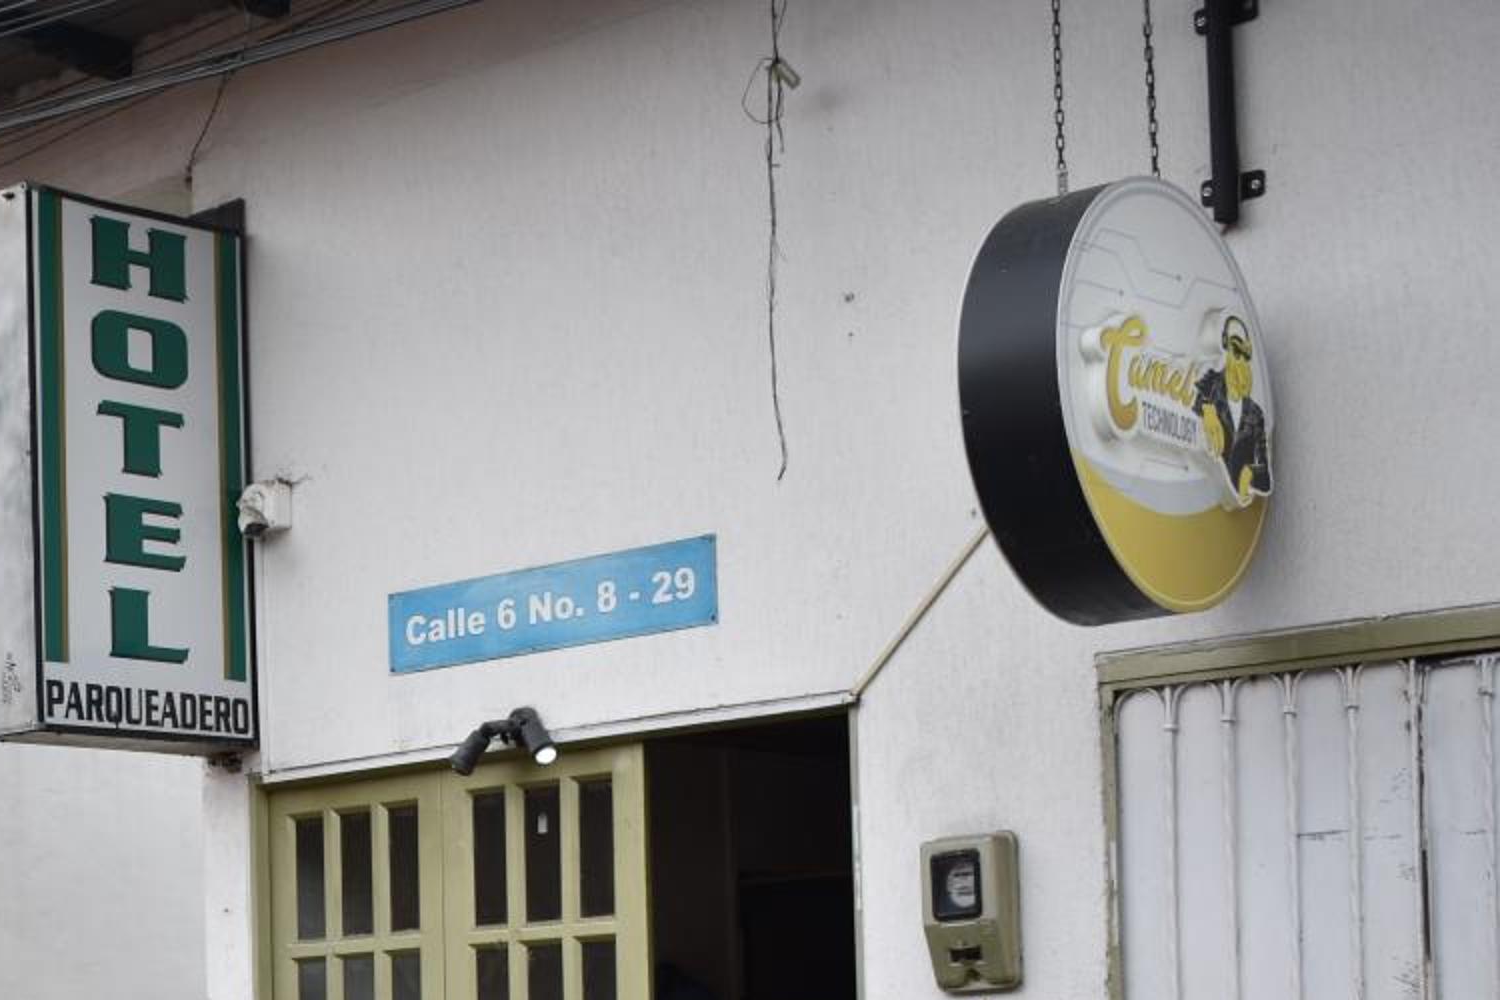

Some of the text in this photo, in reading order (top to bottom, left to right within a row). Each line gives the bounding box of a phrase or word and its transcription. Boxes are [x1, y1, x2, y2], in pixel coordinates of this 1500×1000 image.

[90, 214, 191, 666] HOTEL
[1142, 401, 1198, 445] TECHNOLOGY
[406, 607, 486, 646] Calle
[497, 599, 517, 630] 6
[528, 591, 585, 624] No.
[596, 581, 618, 613] 8
[651, 567, 696, 604] 29
[46, 679, 250, 736] PARQUEADERO
